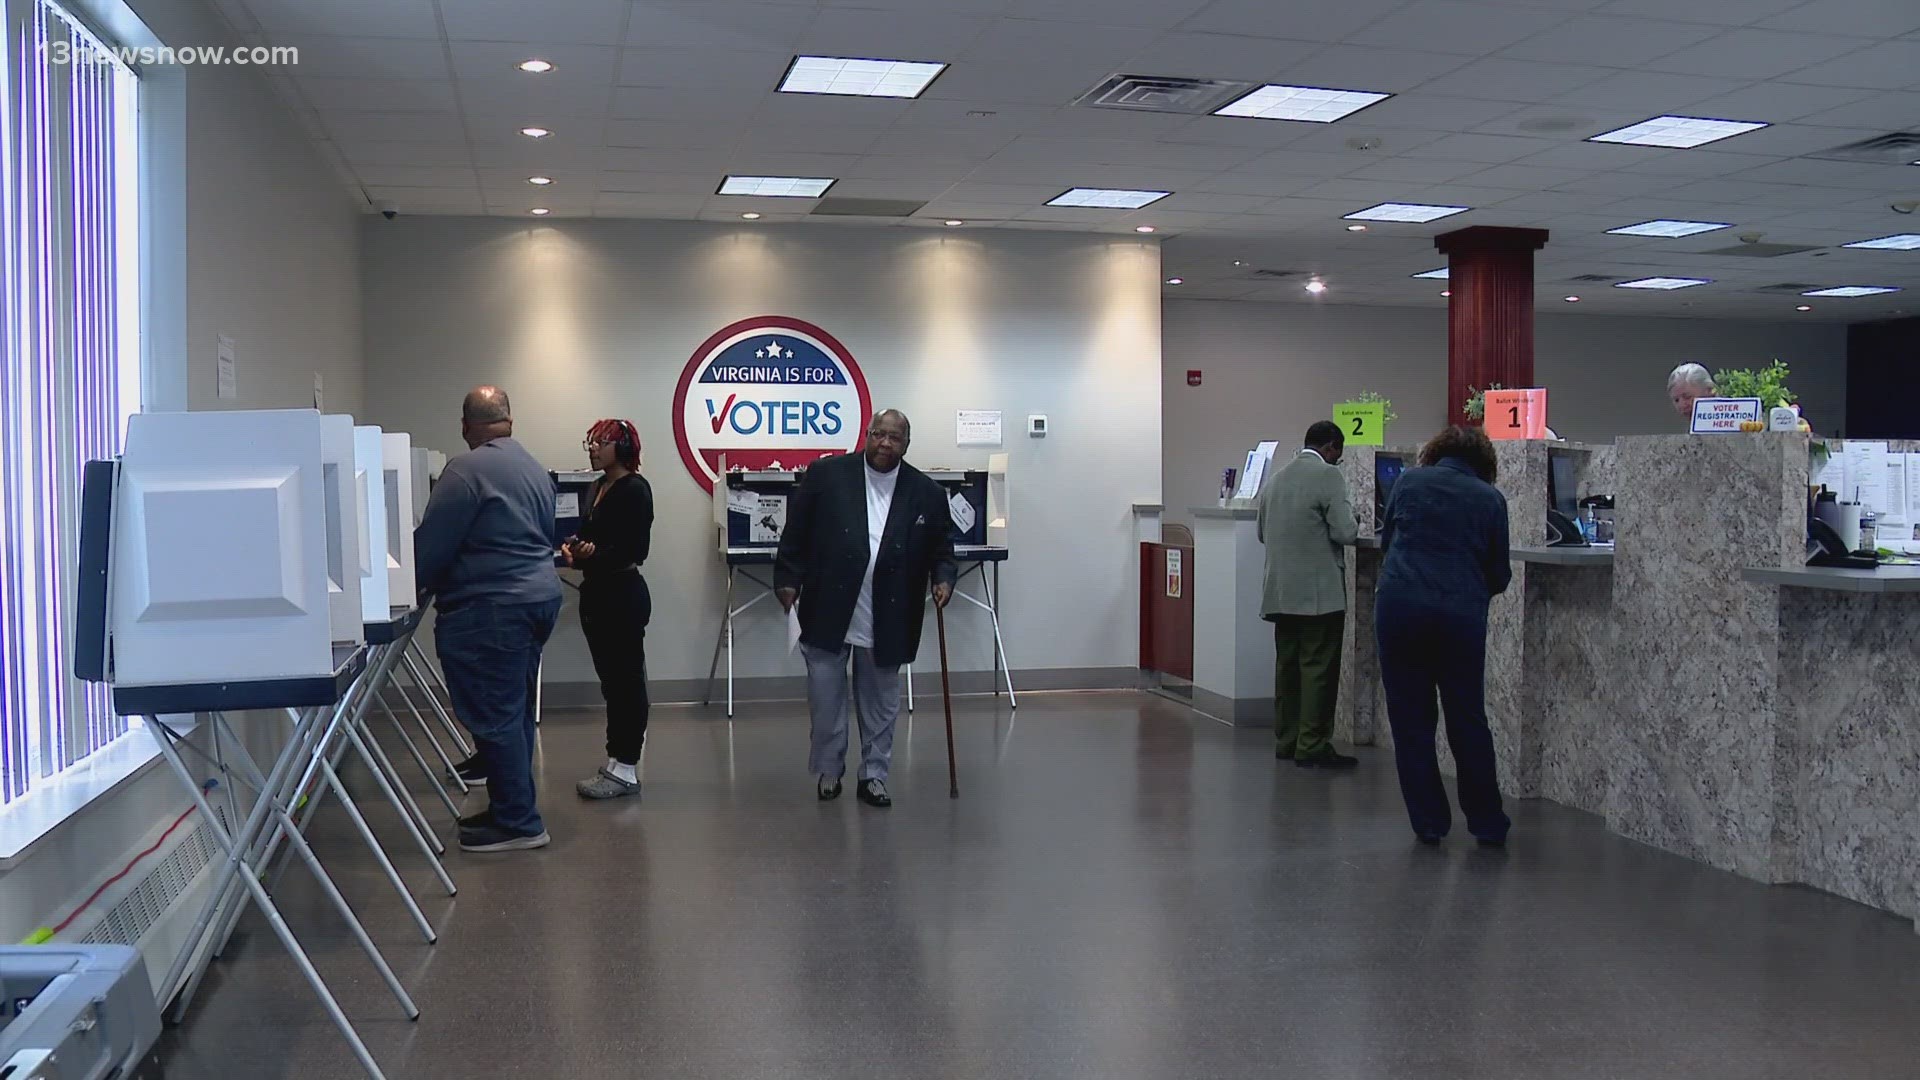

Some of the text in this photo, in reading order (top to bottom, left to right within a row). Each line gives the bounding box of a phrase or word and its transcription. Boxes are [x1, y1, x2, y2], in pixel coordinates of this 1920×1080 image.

[711, 366, 834, 383] VIRGINIA IS FOR
[705, 393, 842, 436] VOTERS
[1508, 406, 1521, 428] 1
[1697, 412, 1753, 420] REGISTRATION
[1352, 417, 1364, 436] 2
[1712, 420, 1735, 428] HERE
